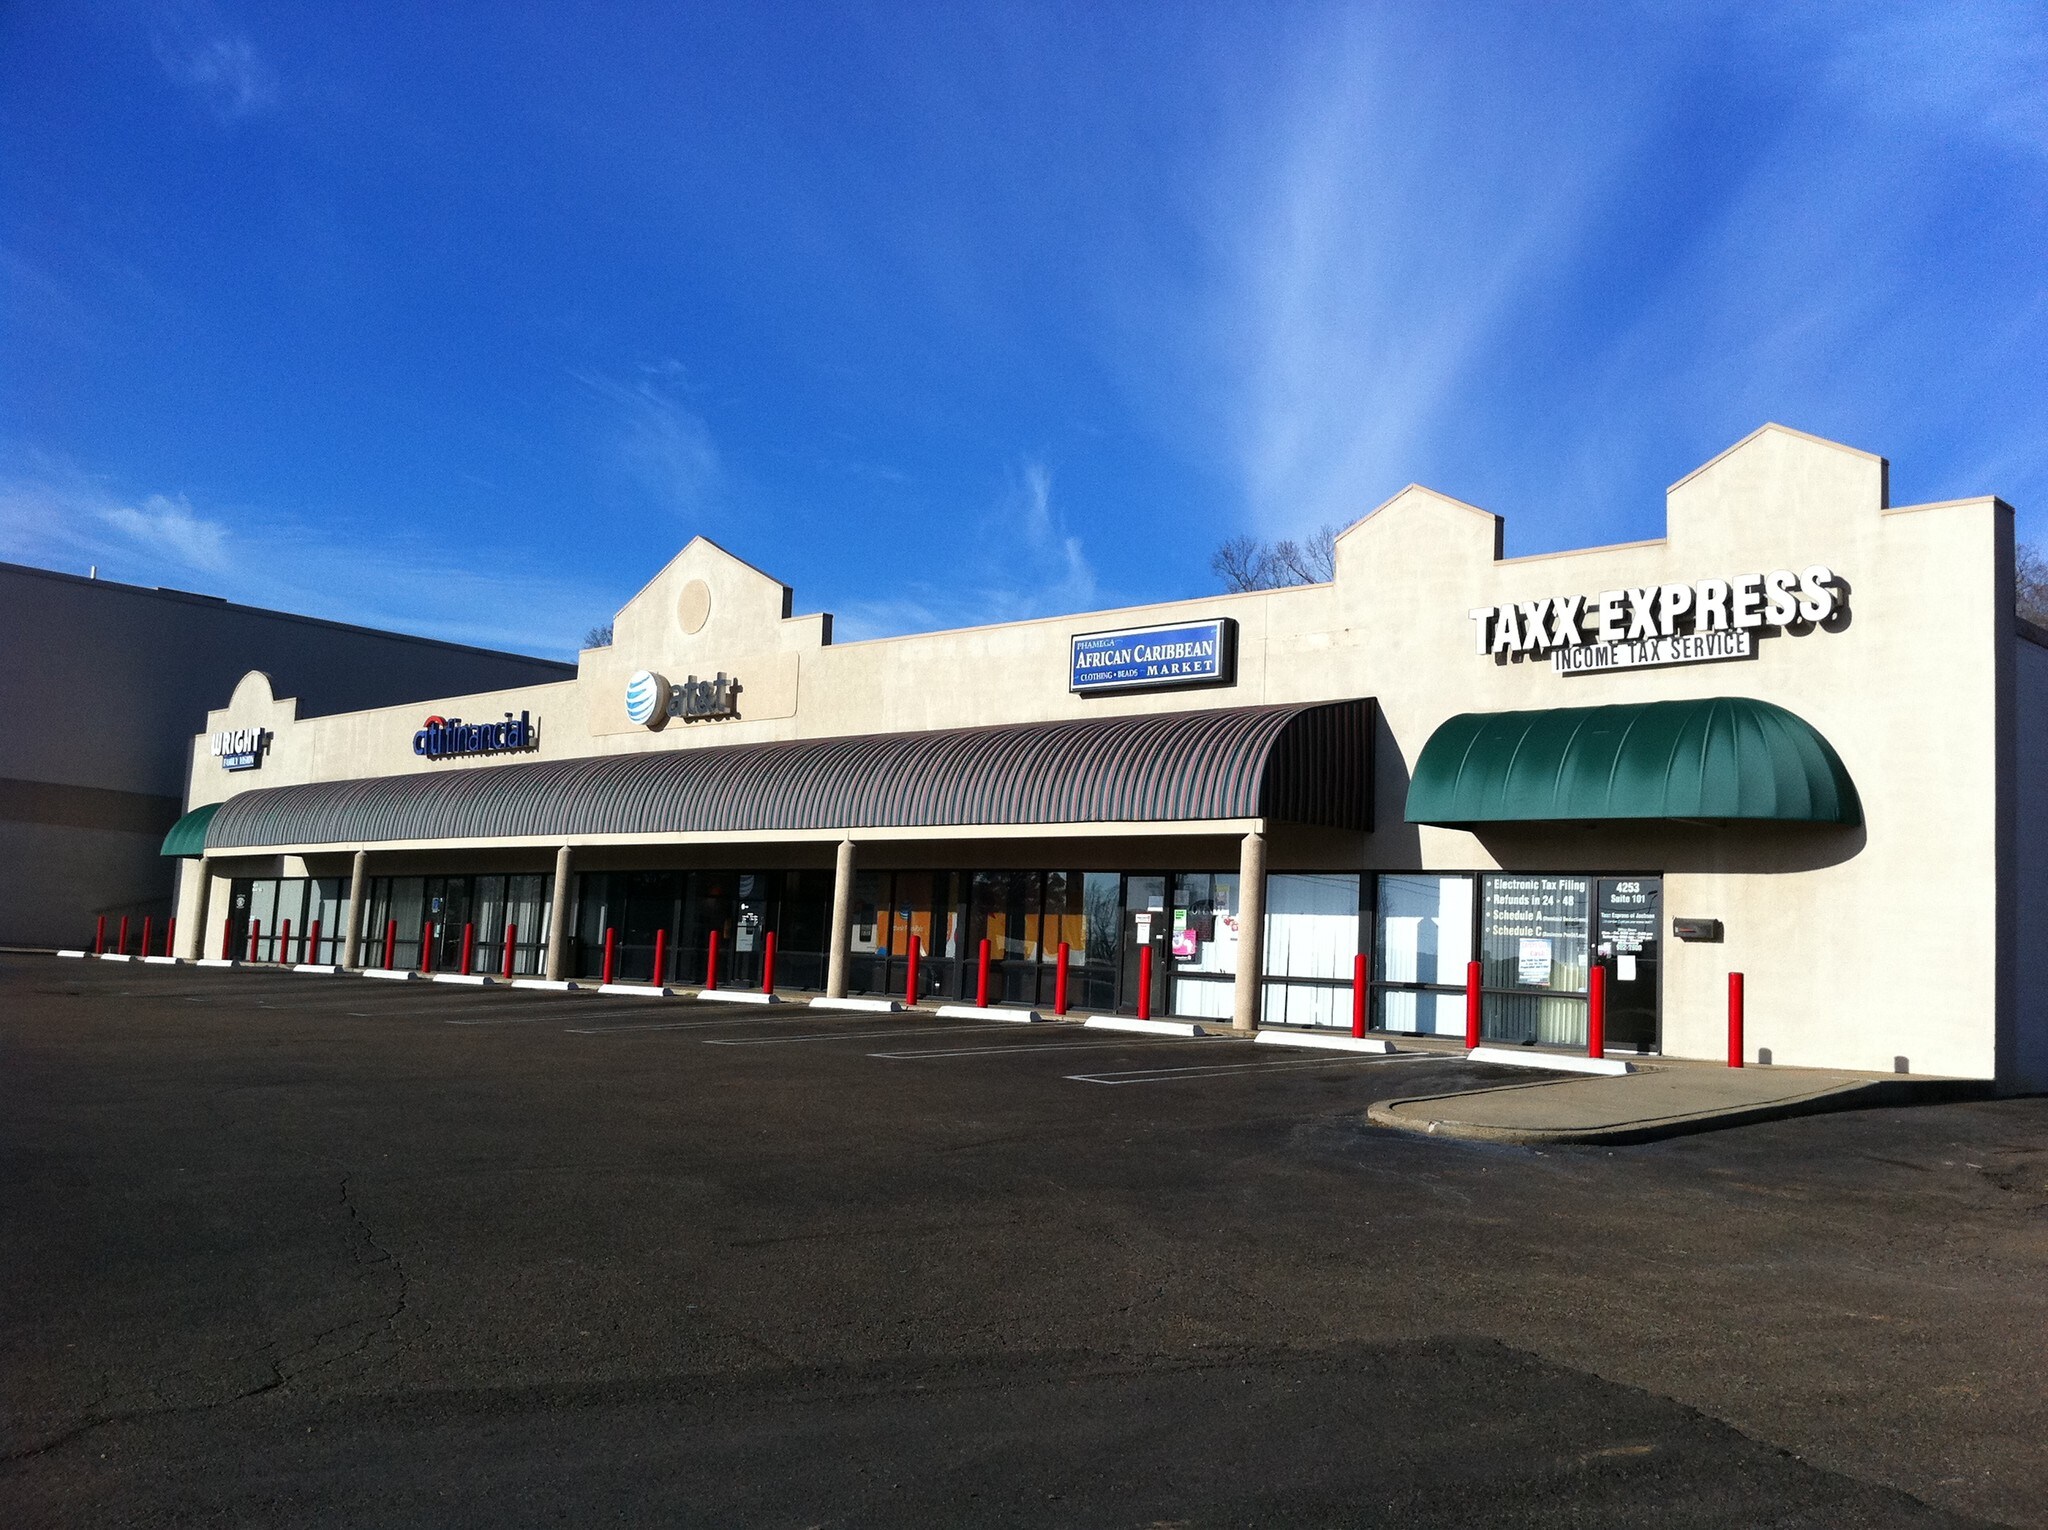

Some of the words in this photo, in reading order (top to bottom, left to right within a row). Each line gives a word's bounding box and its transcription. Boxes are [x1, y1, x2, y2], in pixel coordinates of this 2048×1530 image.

[1468, 594, 1582, 655] TAXX
[1599, 565, 1832, 642] EXPRESS
[1076, 649, 1132, 668] AFRICAN
[1133, 640, 1213, 663] CARIBBEAN
[1555, 643, 1619, 671] INCOME
[1630, 639, 1659, 663] TAX
[1671, 633, 1746, 658] SERVICE
[1146, 660, 1213, 676] MARKET
[1080, 671, 1113, 682] CLOTHING
[1117, 669, 1138, 678] BEADS
[211, 728, 261, 756] WRIGHT
[1494, 879, 1539, 890] Electronic
[1542, 880, 1557, 890] Tax
[1559, 880, 1586, 893] Filing
[1616, 882, 1641, 893] 4253
[1493, 894, 1530, 905] Refunds
[1531, 895, 1541, 905] in
[1542, 895, 1554, 906] 24
[1562, 896, 1575, 906] 48
[1611, 894, 1630, 903] Suite
[1632, 894, 1646, 903] 101
[1493, 909, 1534, 921] Schedule
[1536, 911, 1543, 921] A
[1492, 925, 1534, 936] Schedule
[1536, 926, 1542, 937] C
